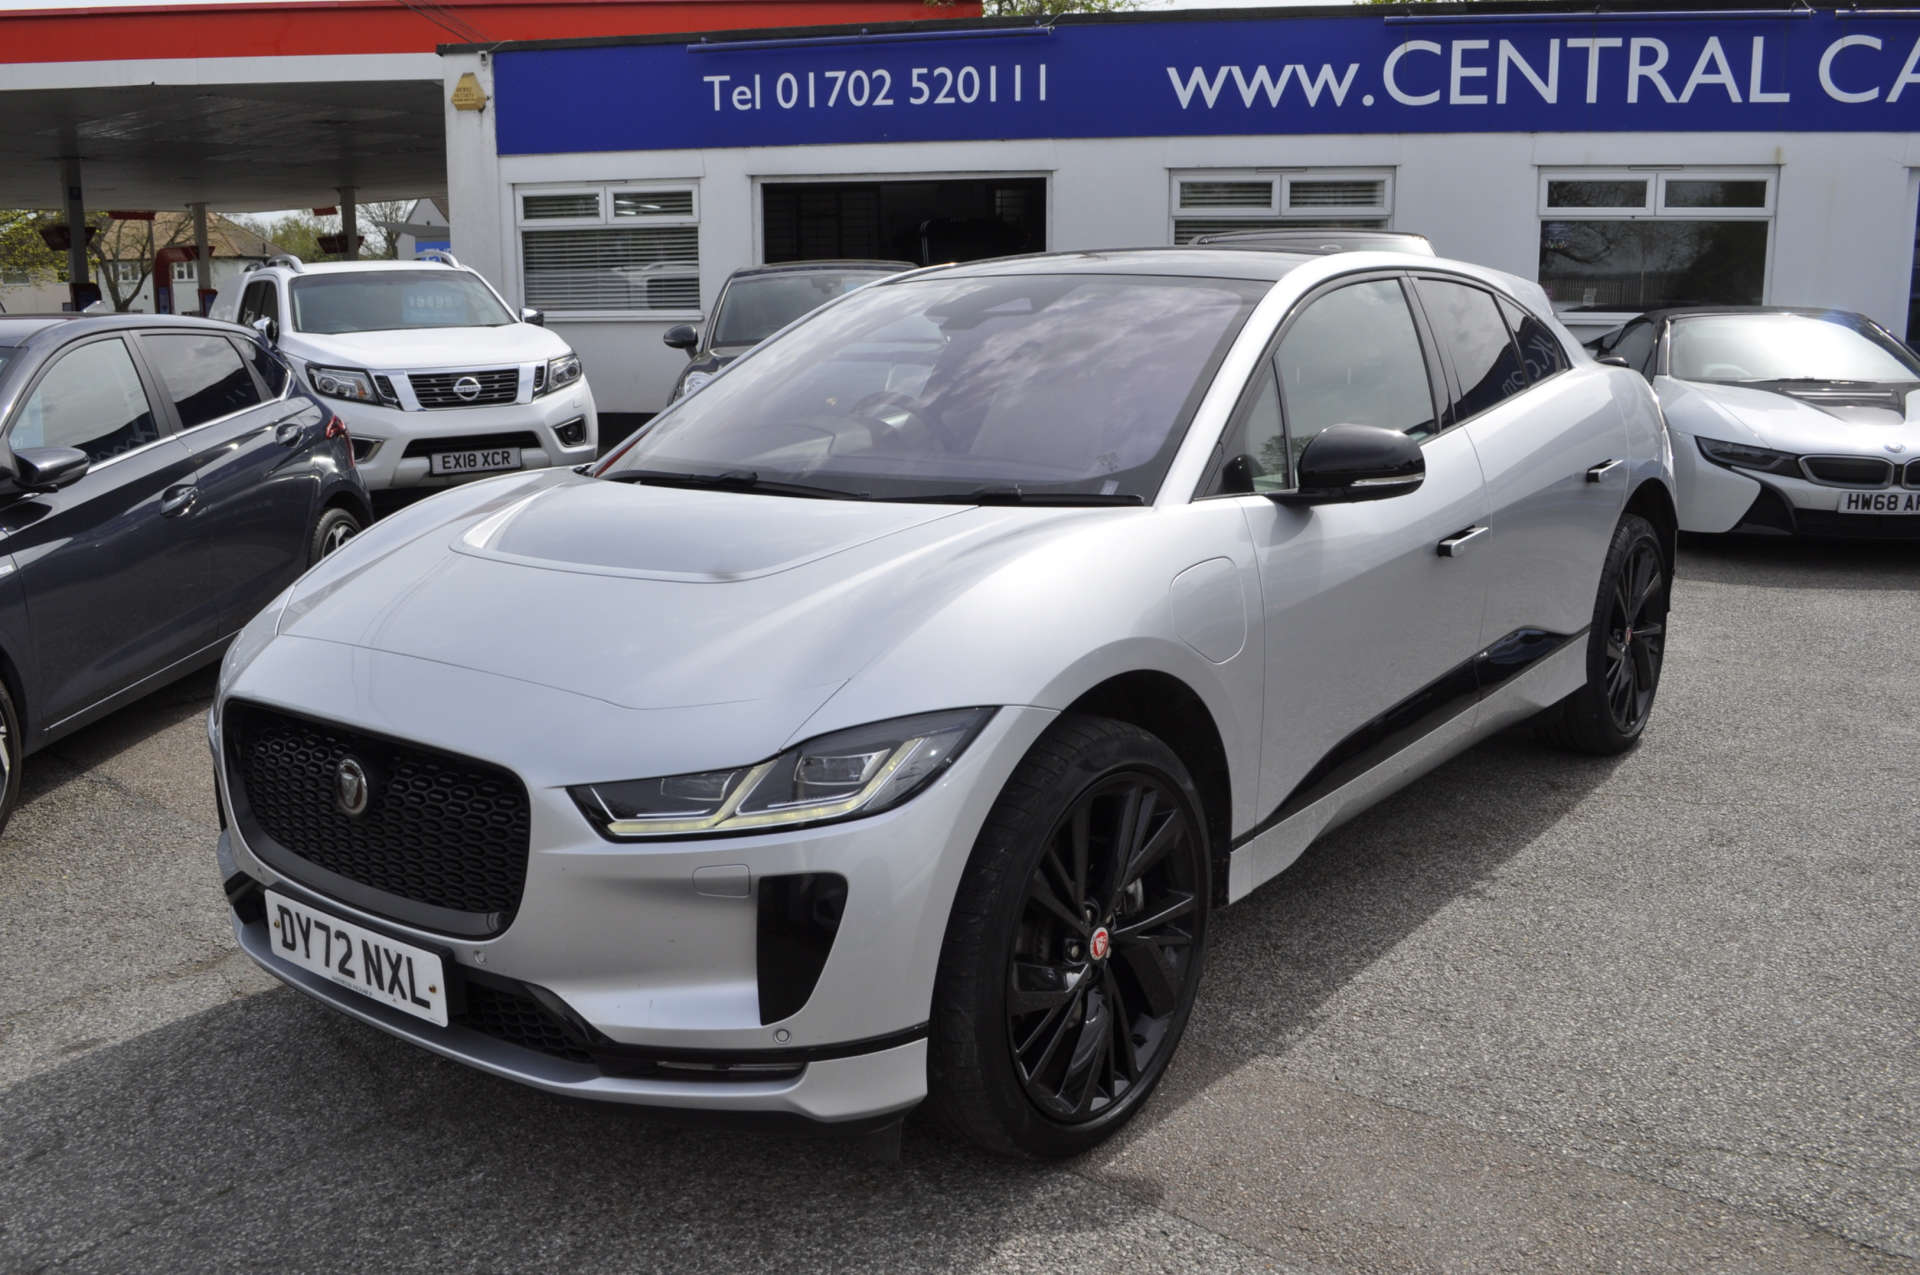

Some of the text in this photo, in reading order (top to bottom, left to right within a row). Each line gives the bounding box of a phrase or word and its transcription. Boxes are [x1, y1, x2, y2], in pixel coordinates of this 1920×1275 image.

[703, 64, 1046, 111] Tel 01702 520111
[441, 450, 511, 470] EX18 XCR
[1847, 493, 1899, 511] HW68
[277, 904, 431, 1010] DY72 NXL
